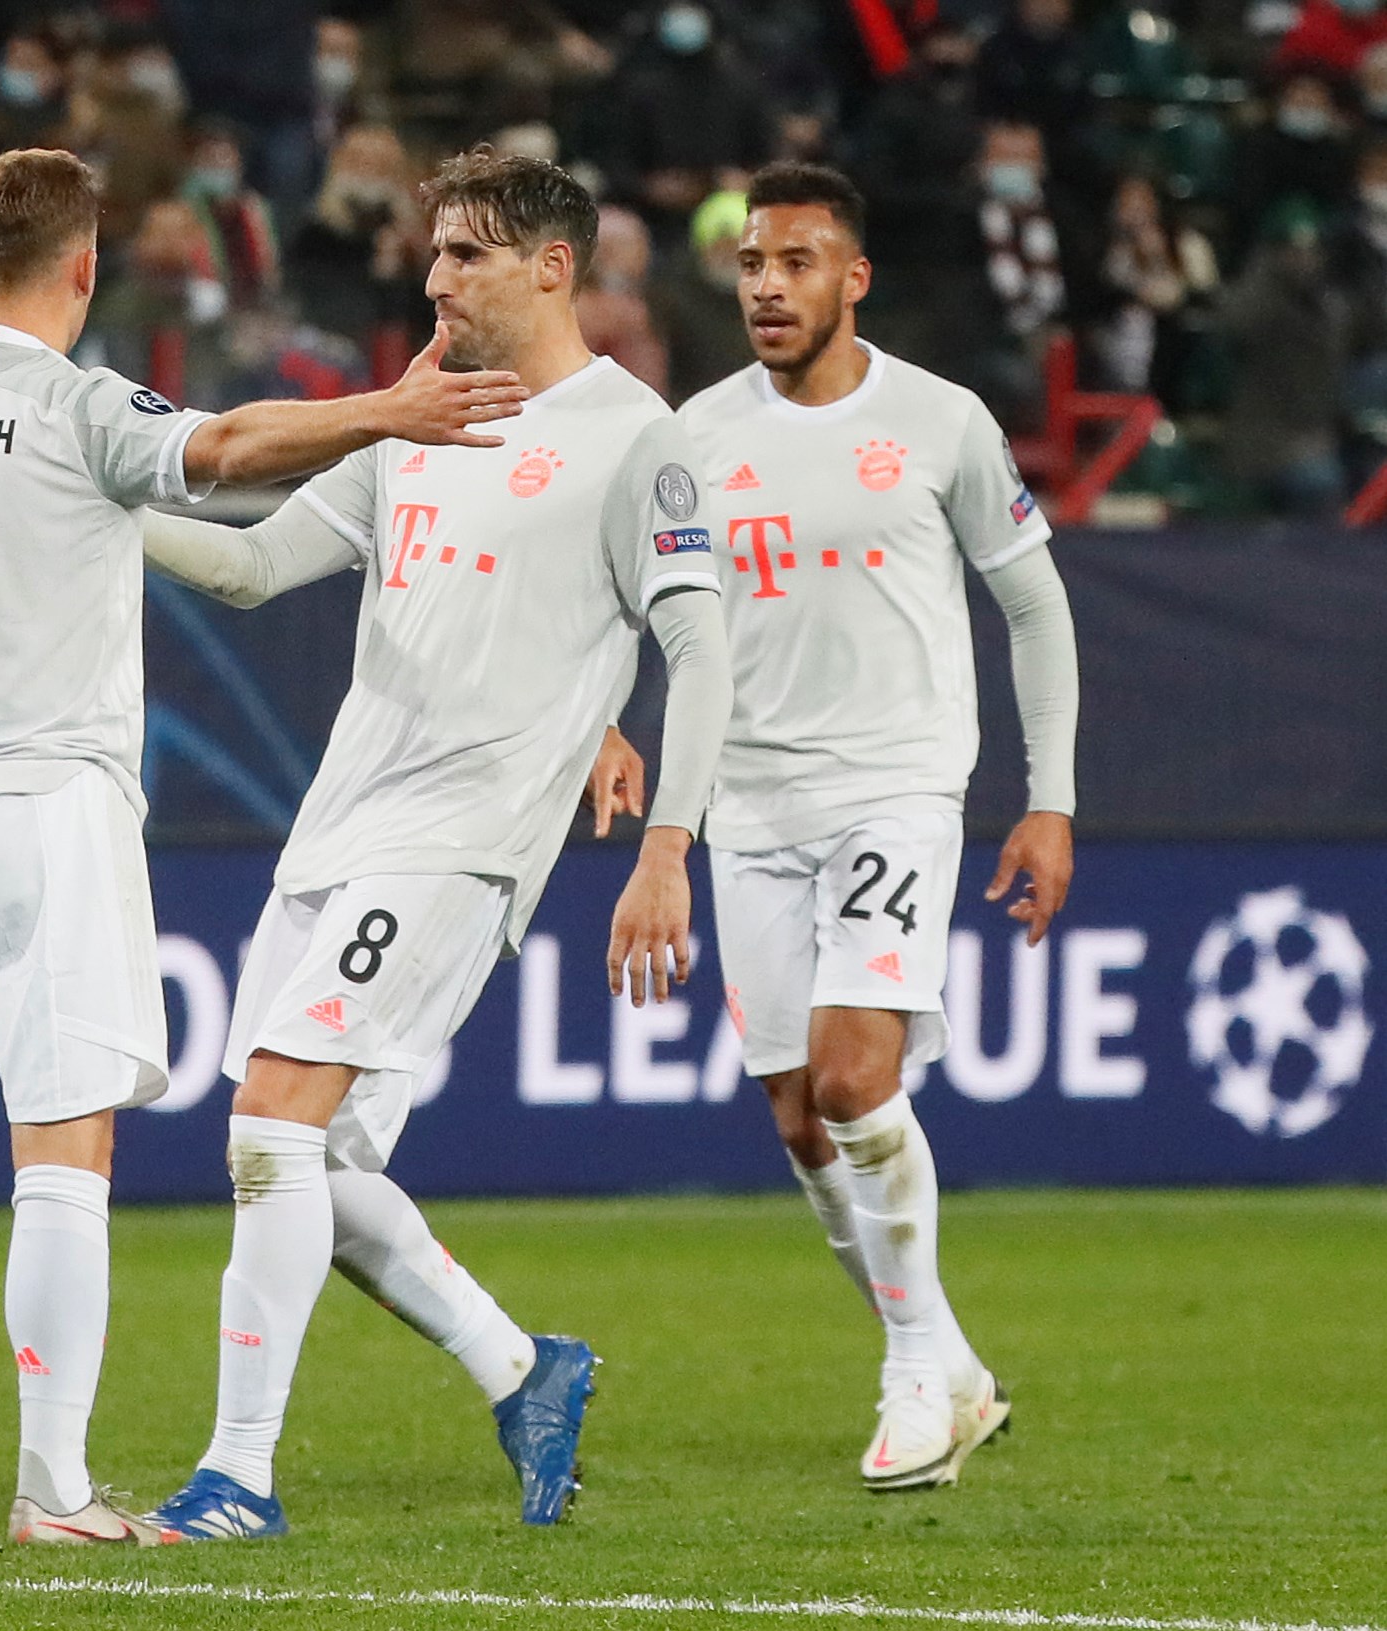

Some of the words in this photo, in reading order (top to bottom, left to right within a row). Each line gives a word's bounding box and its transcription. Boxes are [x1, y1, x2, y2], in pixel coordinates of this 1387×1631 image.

[674, 490, 685, 506] 6
[839, 852, 919, 936] 24
[339, 909, 398, 984] 8
[517, 928, 1147, 1105] LEUE
